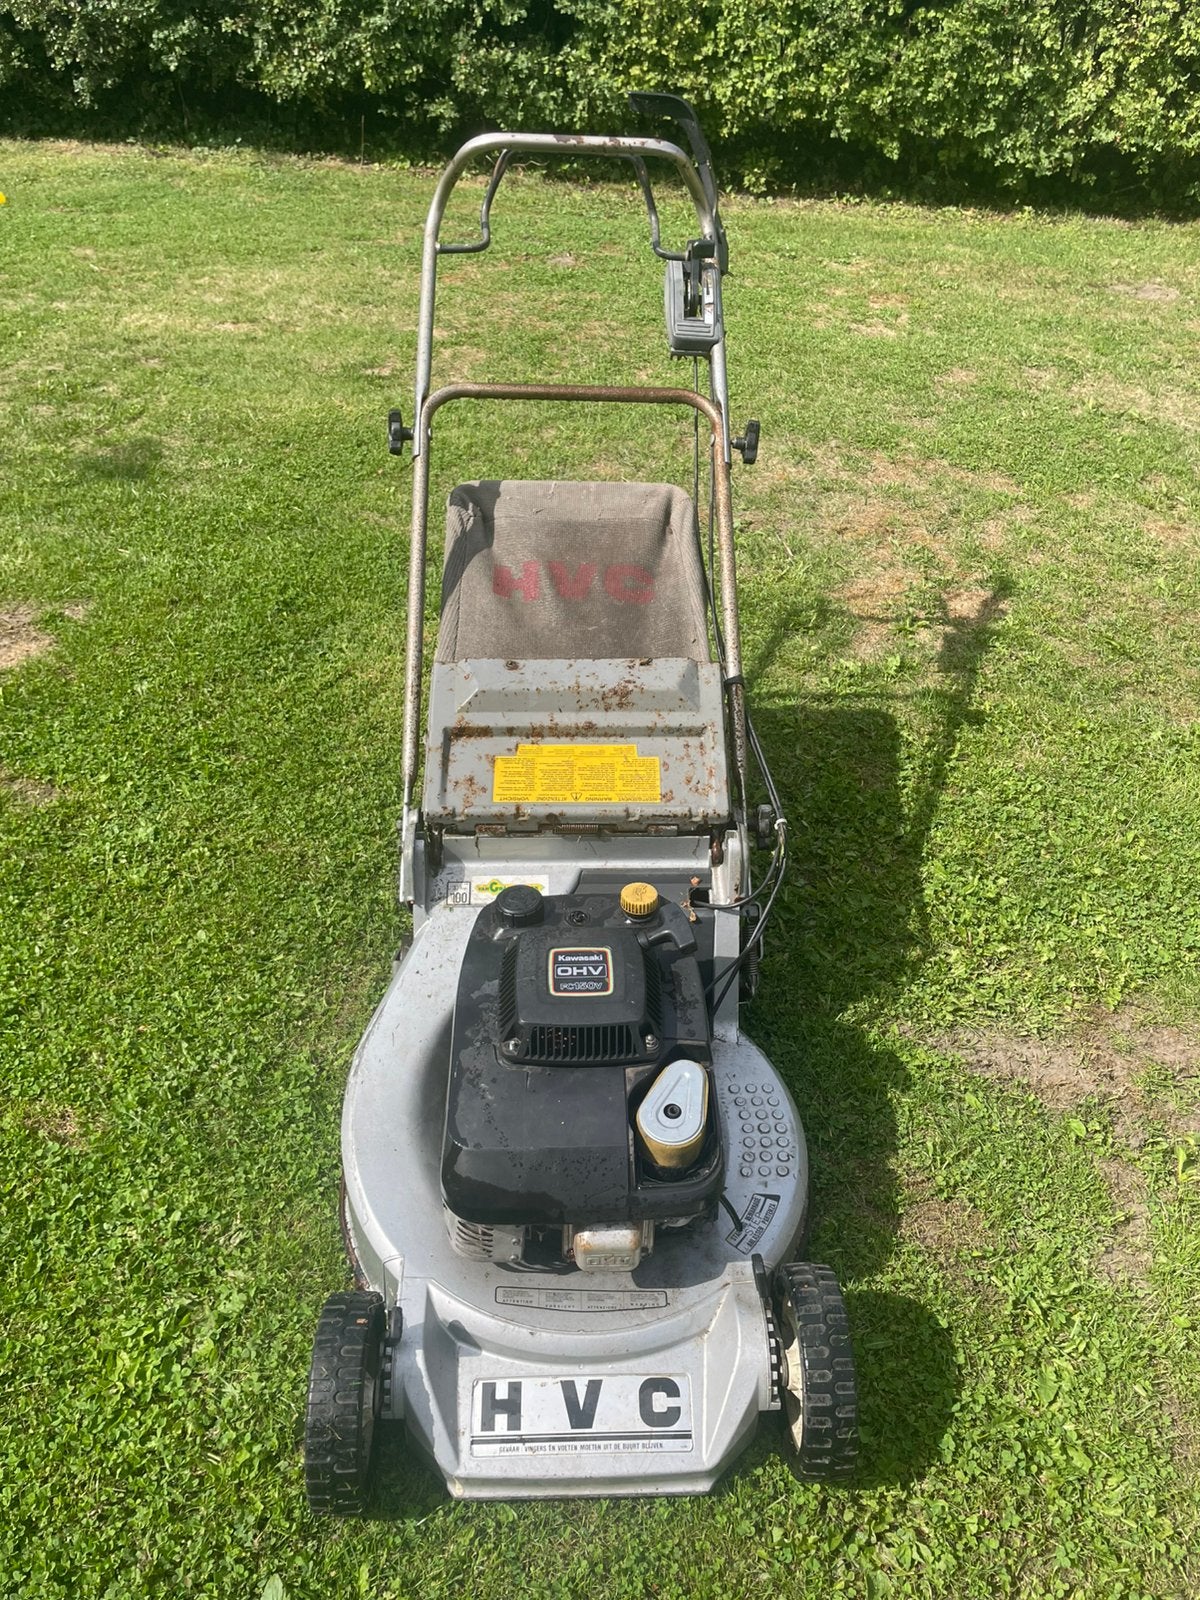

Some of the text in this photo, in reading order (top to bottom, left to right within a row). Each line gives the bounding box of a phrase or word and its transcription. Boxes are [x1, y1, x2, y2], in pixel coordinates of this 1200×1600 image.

[492, 560, 656, 604] HVC
[557, 966, 603, 976] OHV
[560, 981, 602, 990] FC150V
[745, 1211, 763, 1236] STEP
[557, 1444, 578, 1452] VOETEN
[580, 1443, 601, 1451] MOETEN
[613, 1442, 620, 1450] DE
[622, 1442, 640, 1450] BUURT
